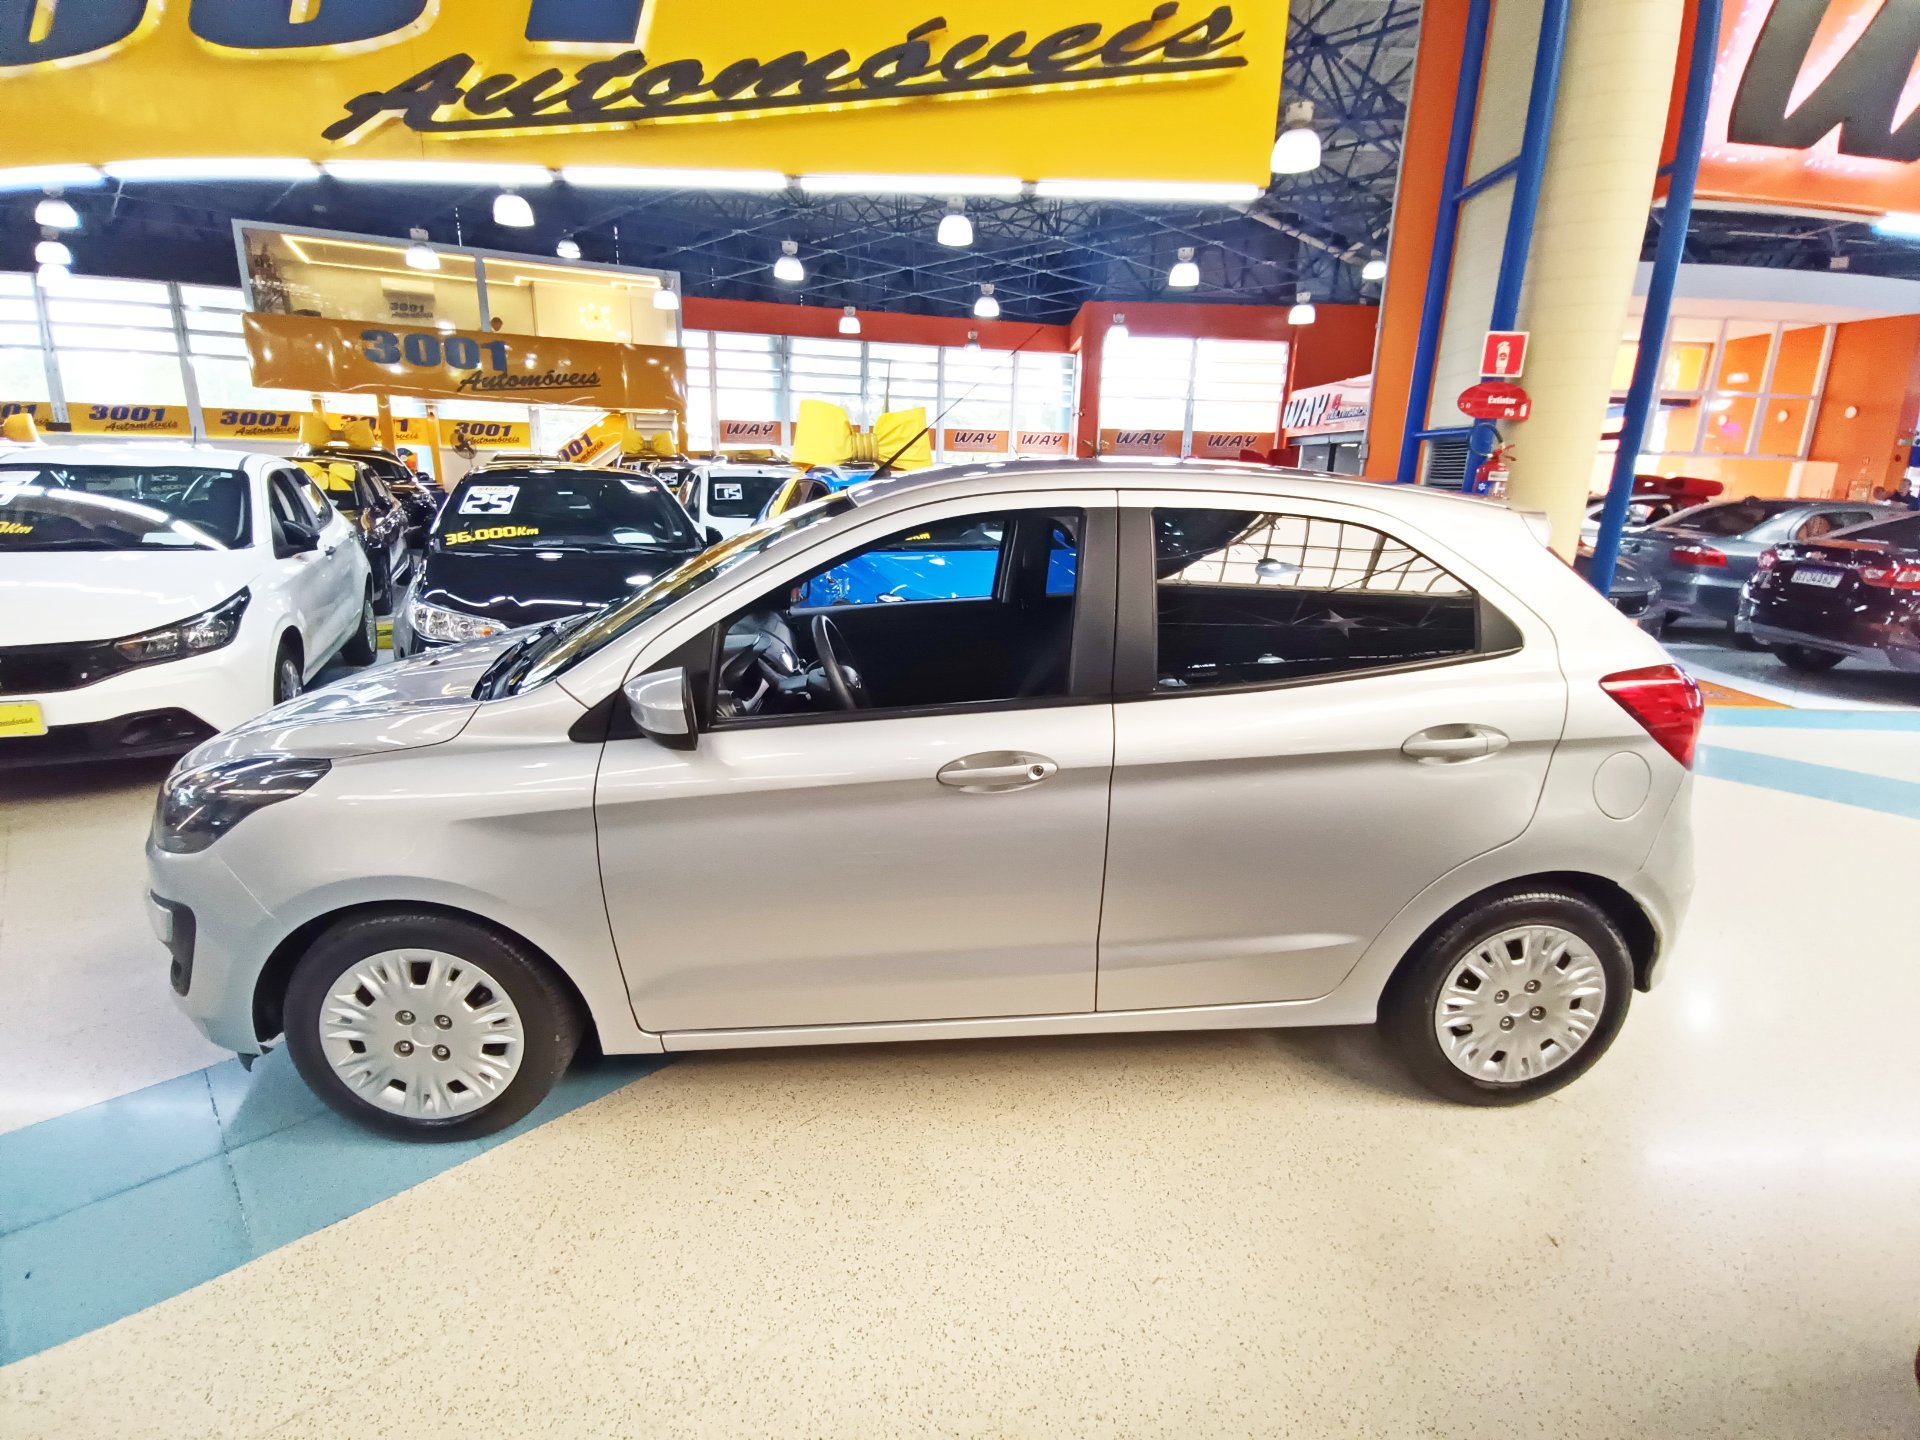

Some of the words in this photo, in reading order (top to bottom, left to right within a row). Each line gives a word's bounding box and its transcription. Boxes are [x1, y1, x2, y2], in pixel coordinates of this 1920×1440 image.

[321, 1, 1247, 140] Automóveis
[360, 329, 508, 371] 3001
[457, 370, 601, 392] Automóveis
[89, 405, 165, 421] 3001
[220, 410, 291, 426] 3001
[1283, 393, 1330, 428] WAY
[456, 422, 512, 437] 3001
[727, 423, 774, 435] WAY
[955, 432, 997, 443] WAY
[1022, 434, 1062, 445] WAY
[1117, 432, 1165, 445] WAY
[1208, 434, 1257, 447] WAY
[463, 493, 514, 512] 25
[444, 526, 539, 546] 36.000Km
